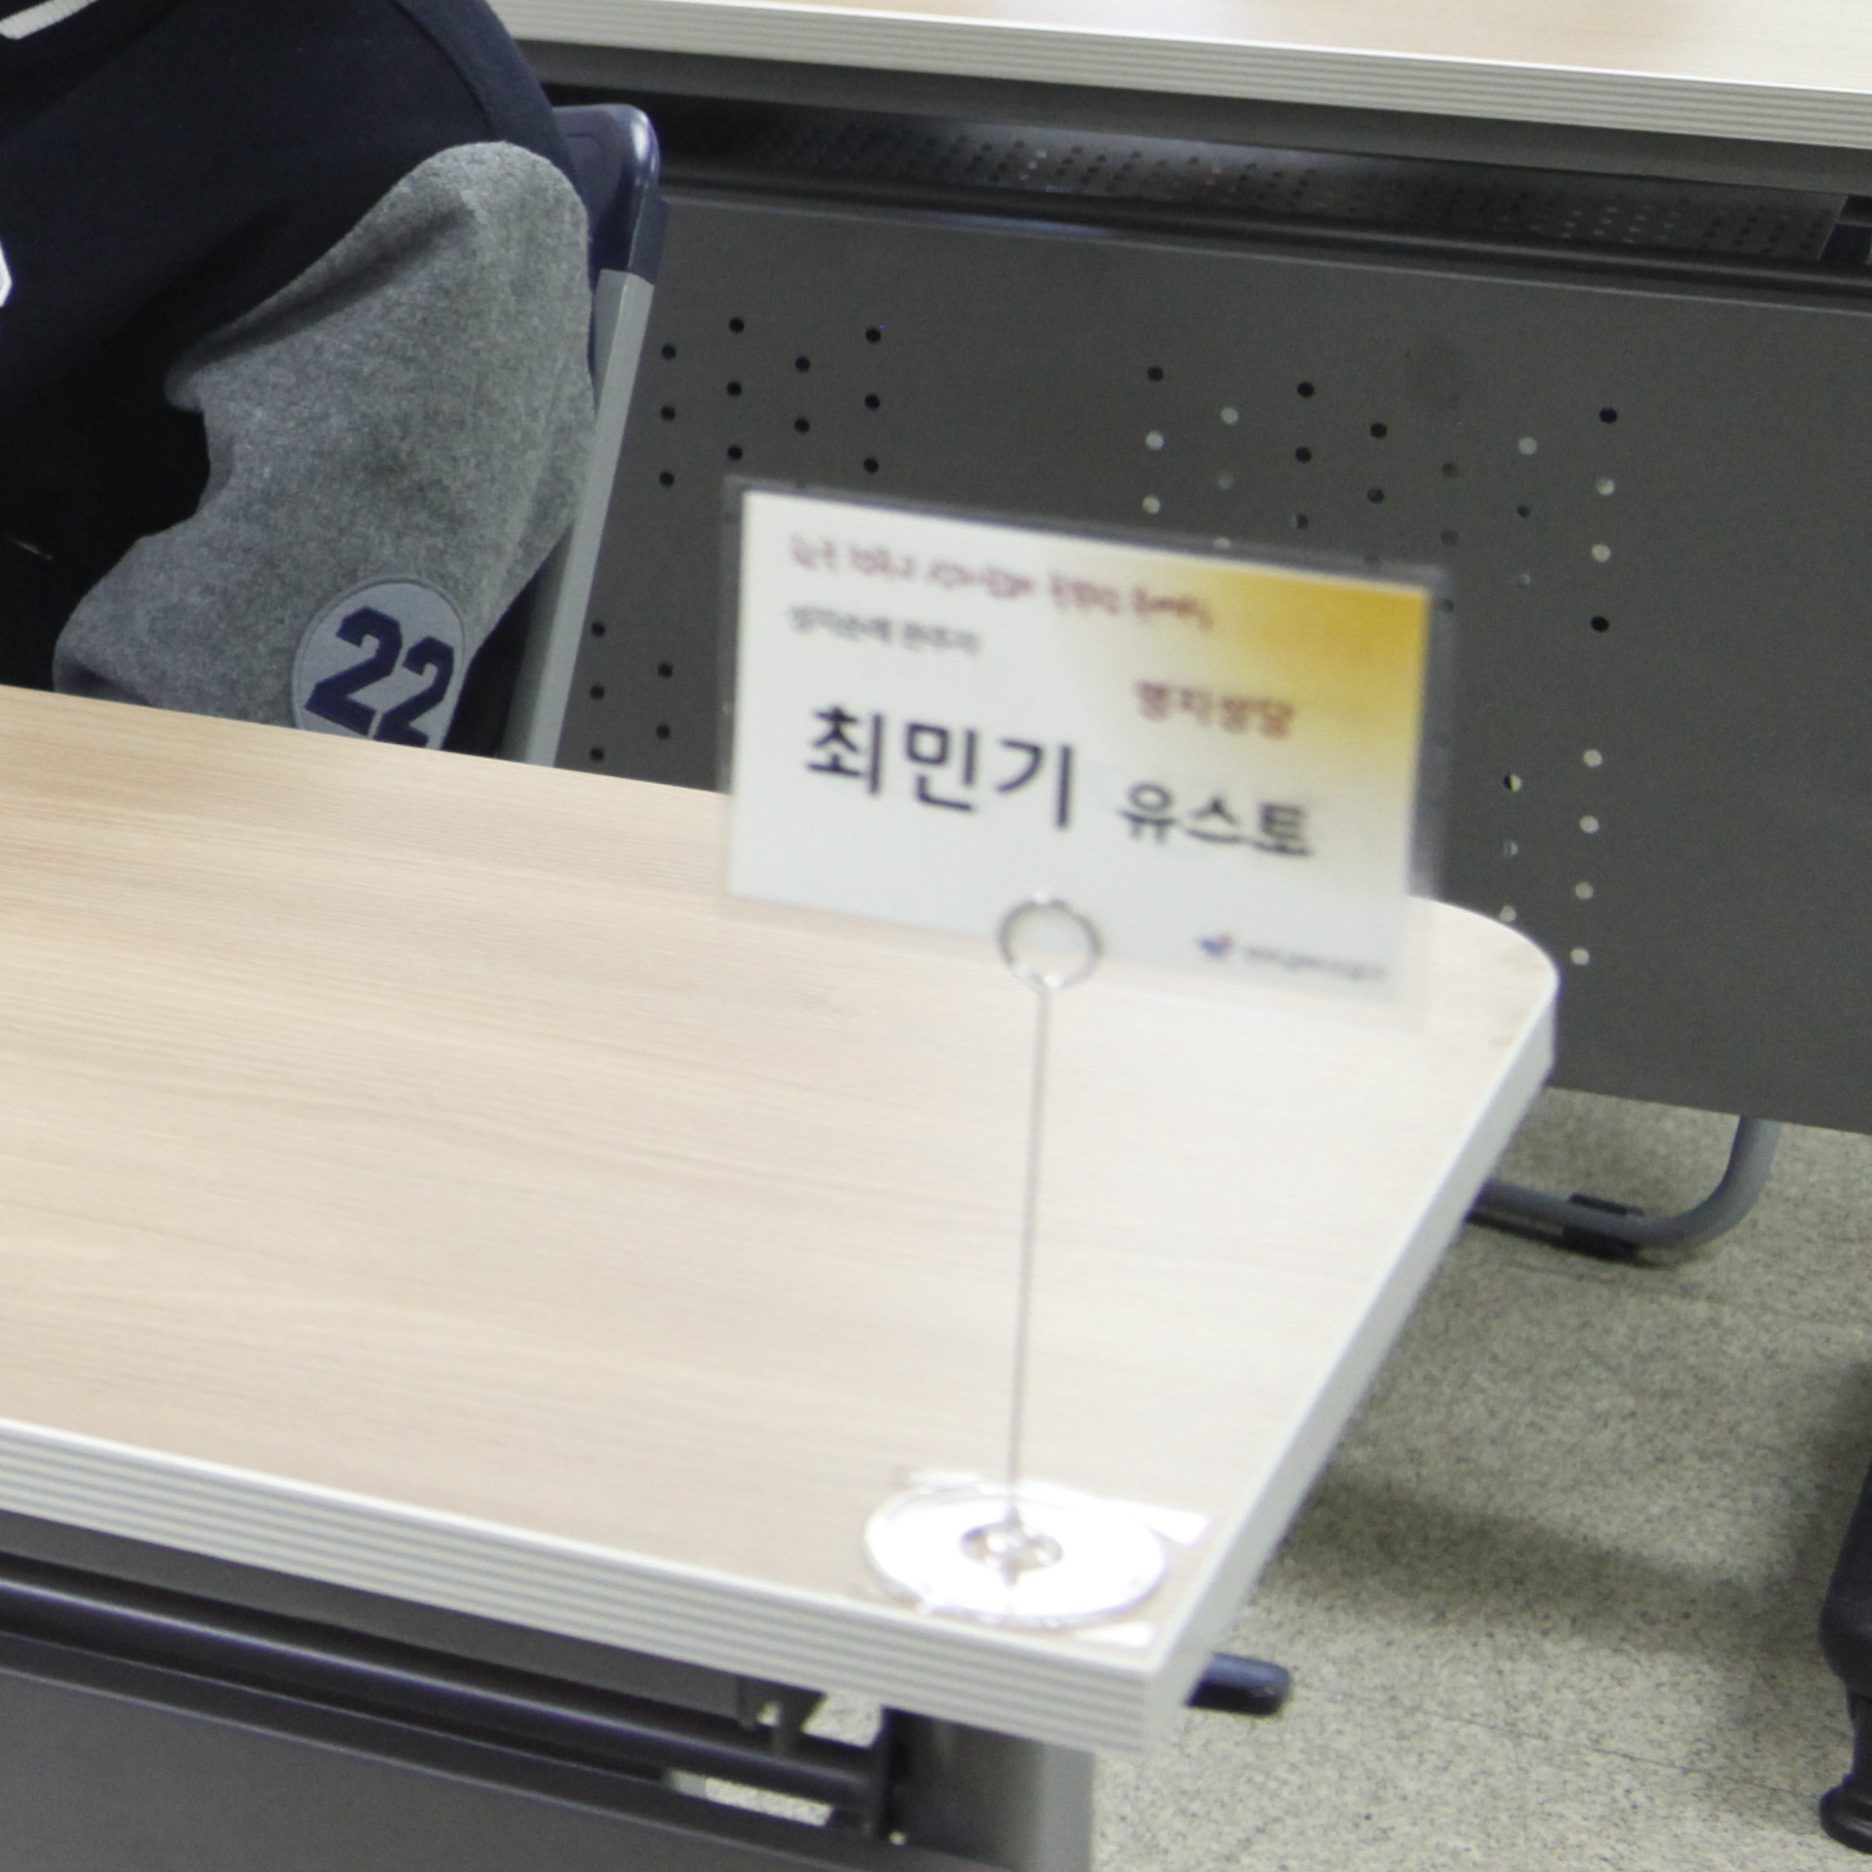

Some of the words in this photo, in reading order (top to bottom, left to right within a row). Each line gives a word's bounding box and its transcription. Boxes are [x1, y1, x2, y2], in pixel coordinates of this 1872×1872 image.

[305, 605, 454, 749] 22
[806, 705, 1074, 831] 최민기
[1119, 782, 1313, 858] 유스토
